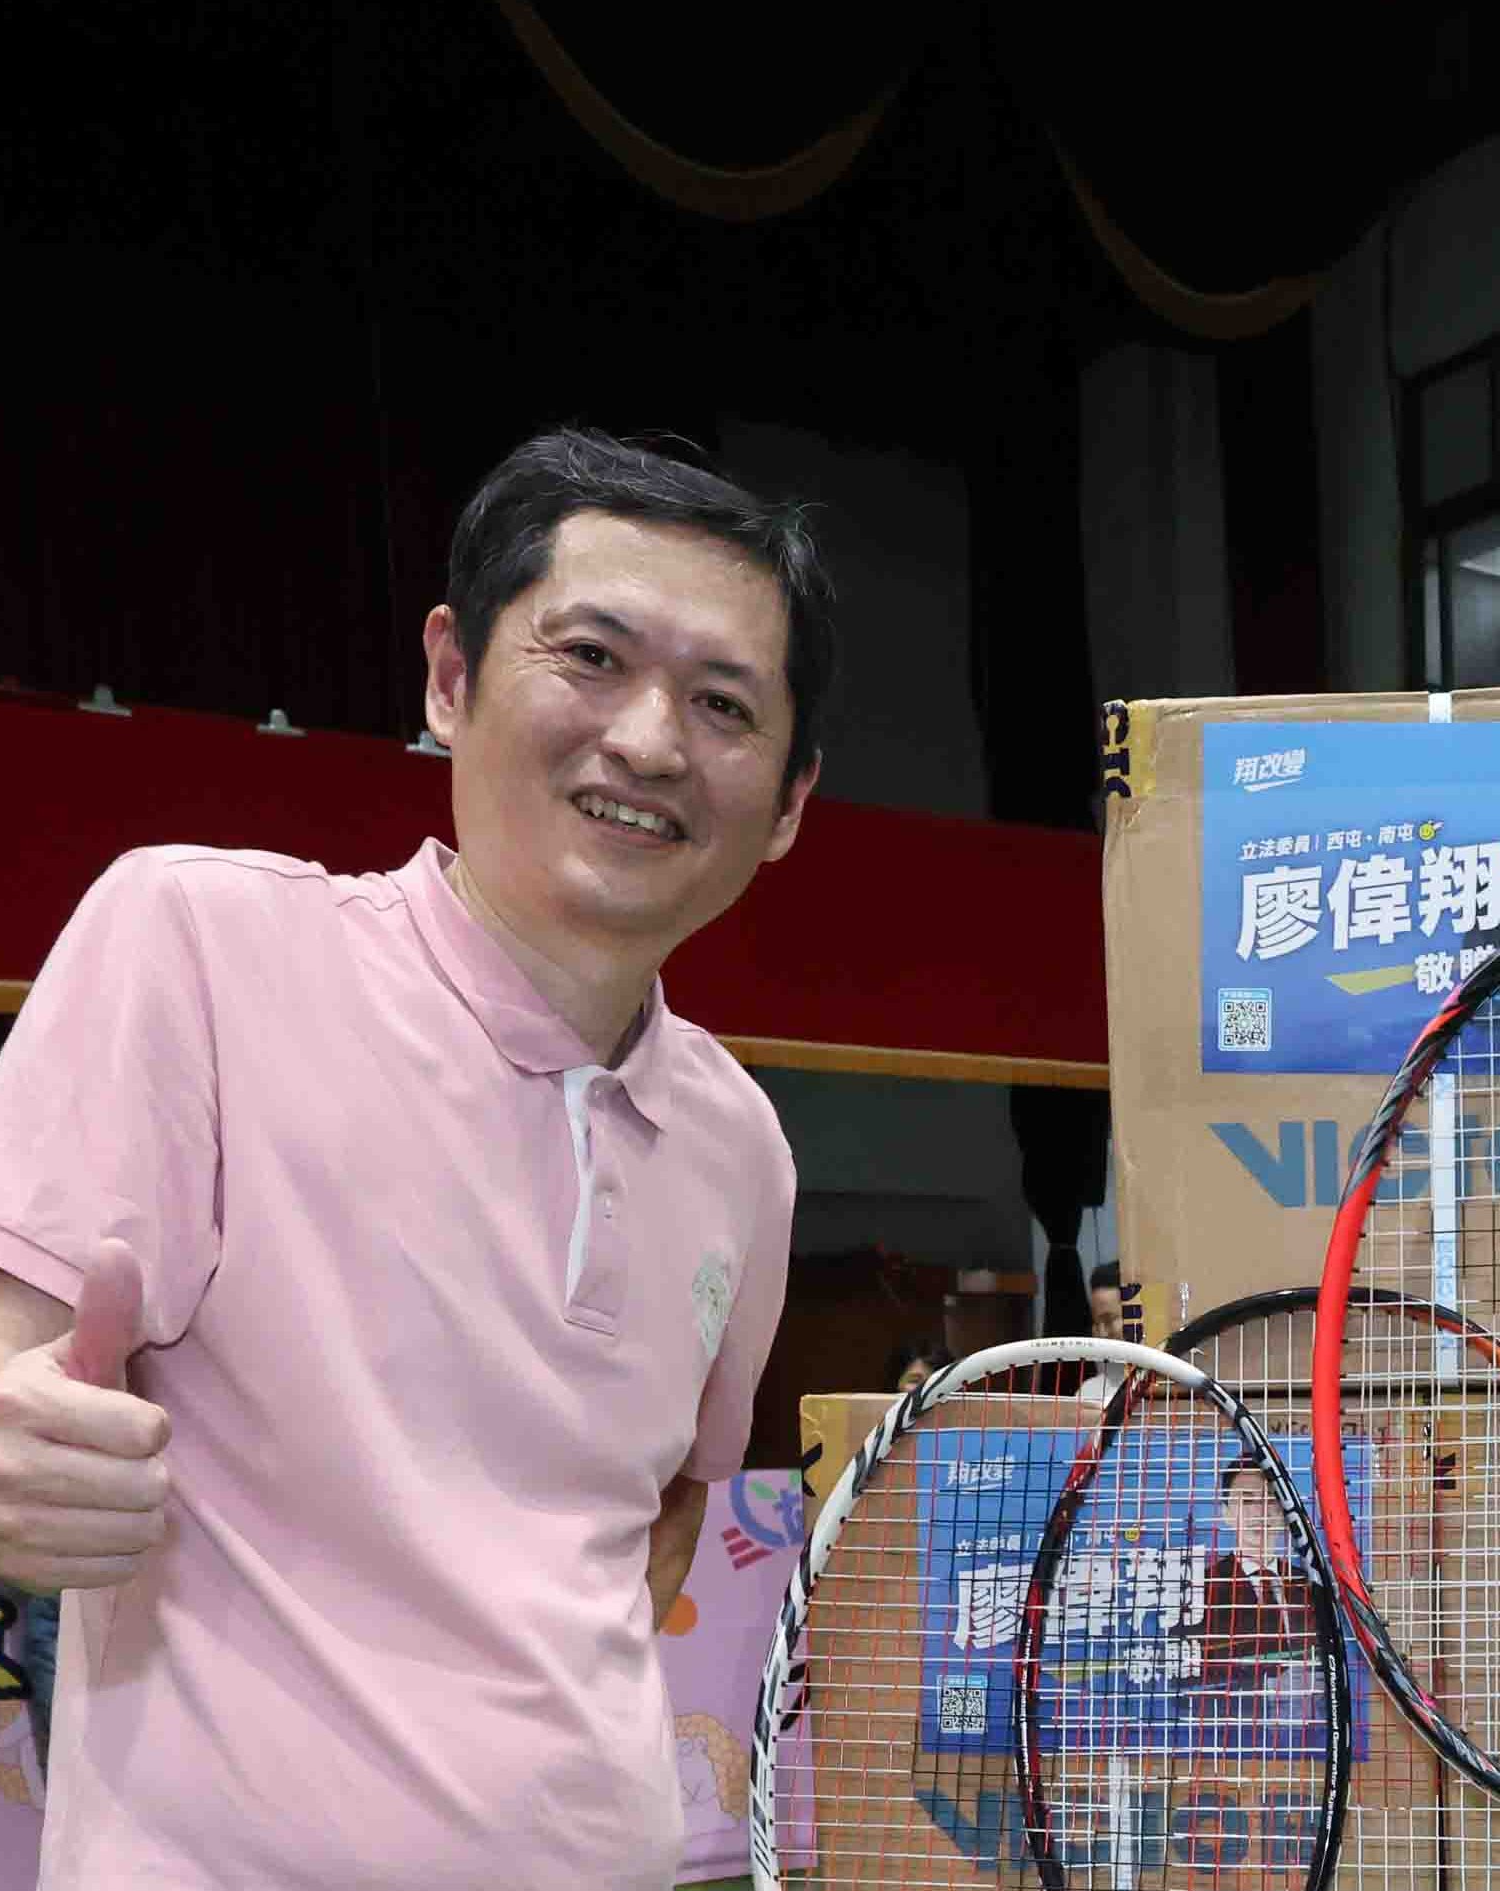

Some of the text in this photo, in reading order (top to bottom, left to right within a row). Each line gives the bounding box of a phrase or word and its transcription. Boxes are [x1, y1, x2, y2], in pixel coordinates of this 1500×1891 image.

[1234, 748, 1306, 785] 翔改變
[1241, 834, 1310, 861] 立法委員
[952, 1544, 1205, 1652] 廖偉翔
[1331, 1731, 1340, 1789] Generator
[1325, 1790, 1337, 1830] System
